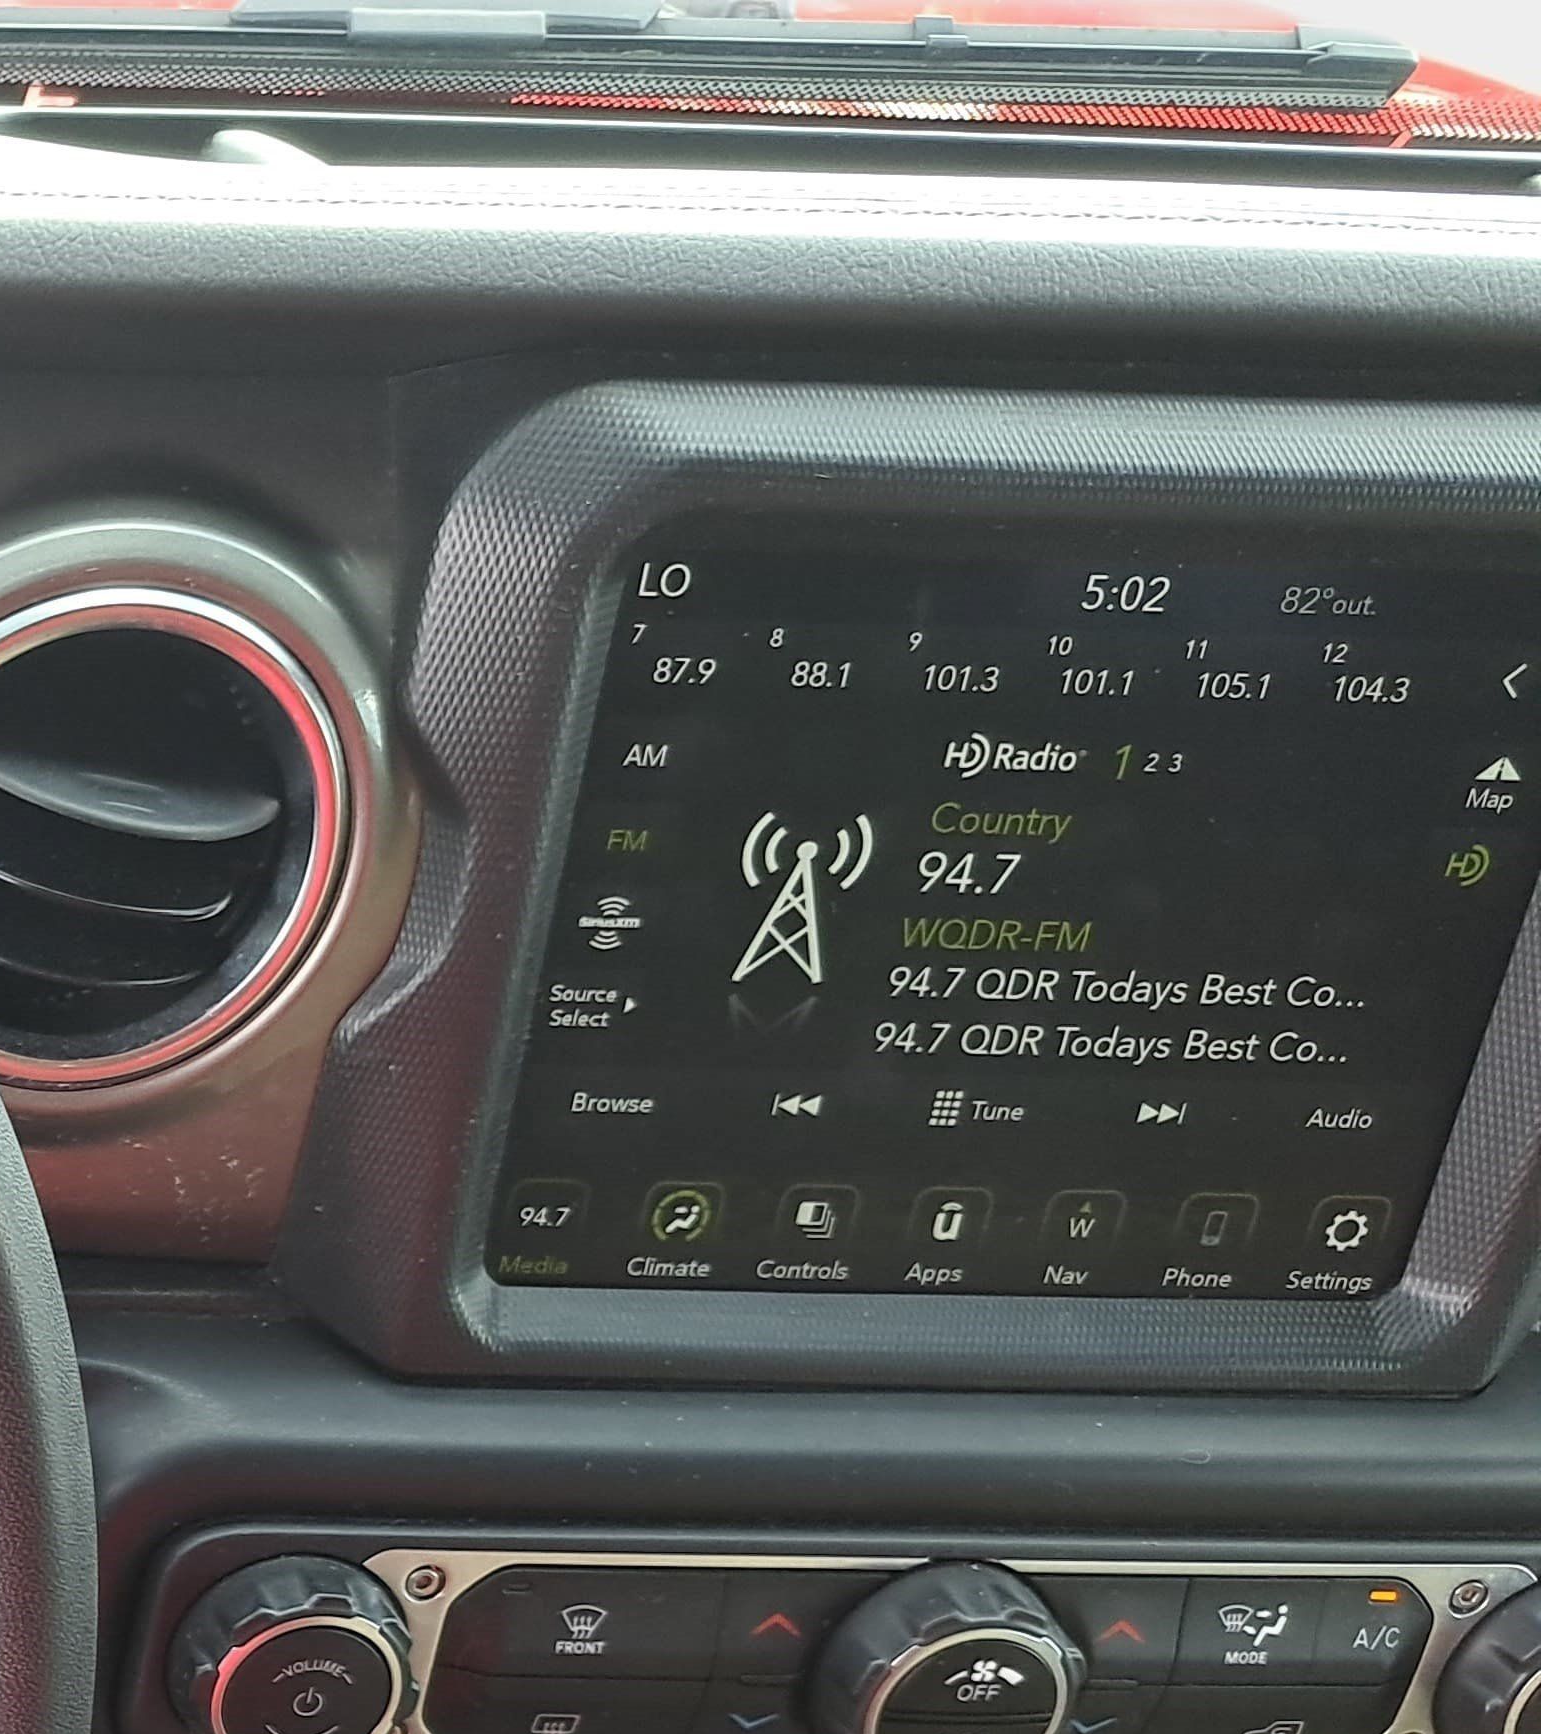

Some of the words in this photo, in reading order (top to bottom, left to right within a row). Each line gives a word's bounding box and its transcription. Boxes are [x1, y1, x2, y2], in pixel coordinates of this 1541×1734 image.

[638, 562, 691, 597] LO
[1081, 574, 1171, 612] 5:02
[632, 623, 648, 644] 7
[769, 627, 785, 648] 8
[909, 631, 923, 652] 9
[1049, 635, 1073, 656] 10
[1186, 639, 1208, 660] 11
[1323, 642, 1349, 663] 12
[653, 657, 717, 684] 87.9
[791, 660, 851, 688] 88.1
[925, 664, 1000, 692] 101.3
[1062, 668, 1134, 696] 101.1
[1199, 672, 1271, 700] 105.1
[1335, 675, 1411, 703] 104.3
[622, 743, 669, 767] AM
[992, 742, 1077, 772] Radio
[1116, 744, 1132, 780] 1
[1143, 752, 1160, 772] 2
[1168, 753, 1183, 773] 3
[1465, 787, 1514, 814] Map
[931, 801, 1073, 844] Country
[607, 829, 648, 851] FM
[919, 851, 1022, 894] 94.7
[904, 917, 1092, 953] WQDR-FM
[549, 984, 618, 1003] Source
[889, 966, 967, 998] 94.7
[976, 968, 1060, 1001] QDR
[1072, 969, 1189, 1010] Todays
[1199, 973, 1278, 1006] Best
[1287, 976, 1364, 1008] Co...
[548, 1008, 611, 1027] Select
[875, 1022, 952, 1054] 94.7
[961, 1024, 1045, 1056] QDR
[1056, 1025, 1173, 1066] Todays
[1183, 1029, 1261, 1061] Best
[1269, 1031, 1347, 1063] Co...
[571, 1092, 654, 1113] Browse
[972, 1100, 1025, 1121] Tune
[1305, 1108, 1373, 1129] Audio
[520, 1207, 571, 1227] 94.7
[1070, 1217, 1096, 1238] W
[498, 1255, 569, 1275] Media
[627, 1256, 711, 1277] Climate
[756, 1259, 849, 1280] Controls
[904, 1262, 963, 1286] Apps
[1043, 1265, 1089, 1285] Nav
[1161, 1267, 1232, 1288] Phone
[1285, 1270, 1373, 1295] Settings
[555, 1640, 606, 1654] FRONT
[1352, 1625, 1401, 1651] A/C
[281, 1659, 346, 1678] VOLUME
[1224, 1651, 1268, 1665] MODE
[956, 1684, 1002, 1702] OFF
